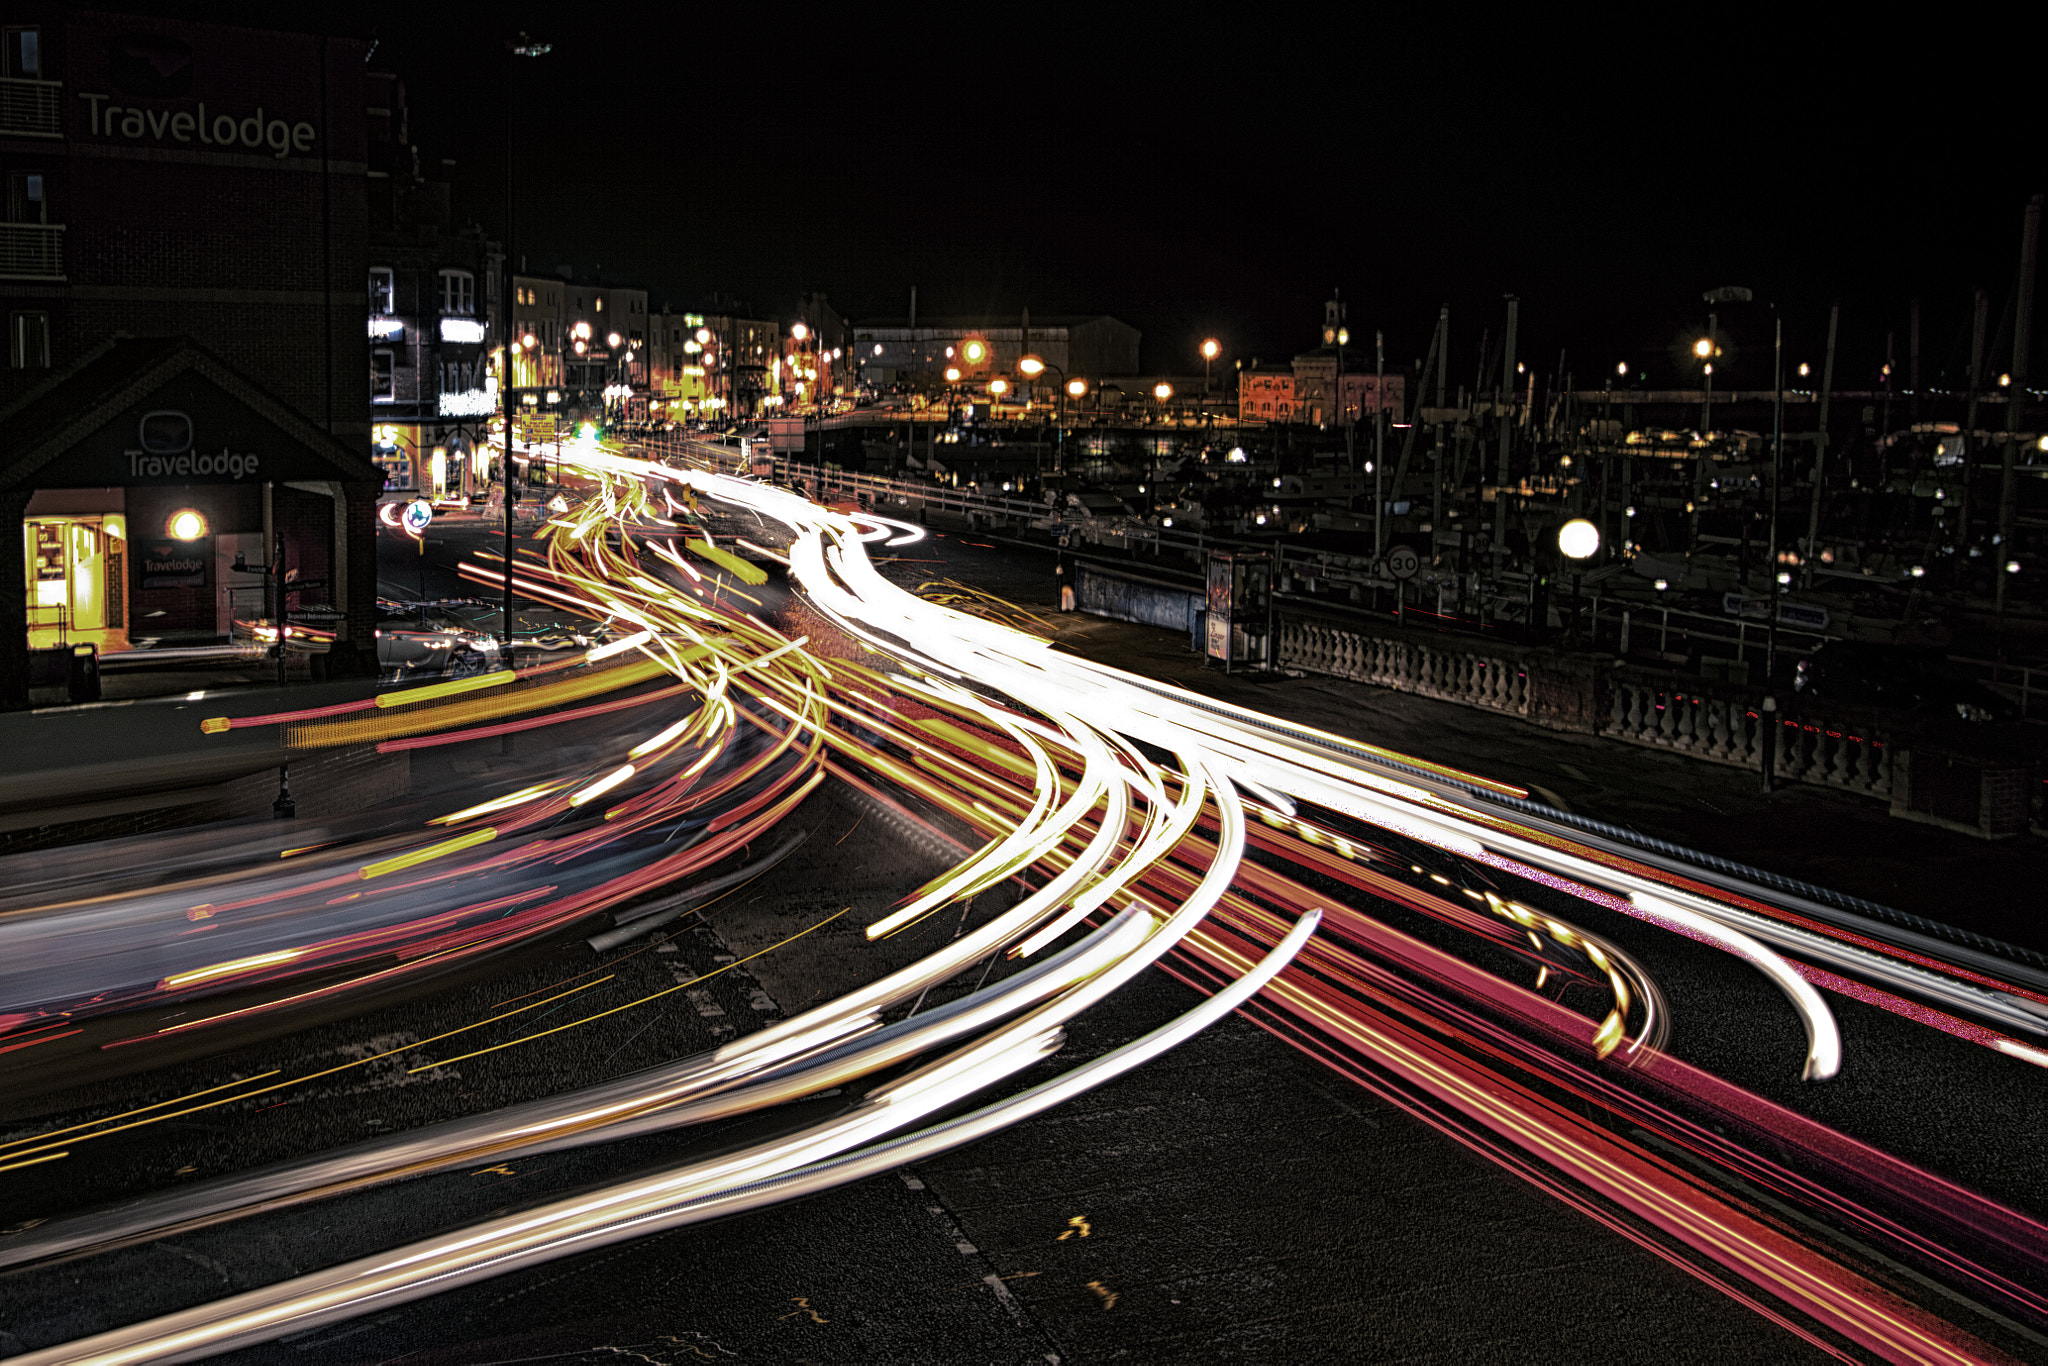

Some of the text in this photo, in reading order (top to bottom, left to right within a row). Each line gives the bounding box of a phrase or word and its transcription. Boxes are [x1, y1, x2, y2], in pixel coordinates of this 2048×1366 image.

[78, 92, 316, 159] Travelodge
[123, 448, 260, 480] Travelodge
[144, 557, 204, 573] Travelodge
[1392, 557, 1416, 570] 30
